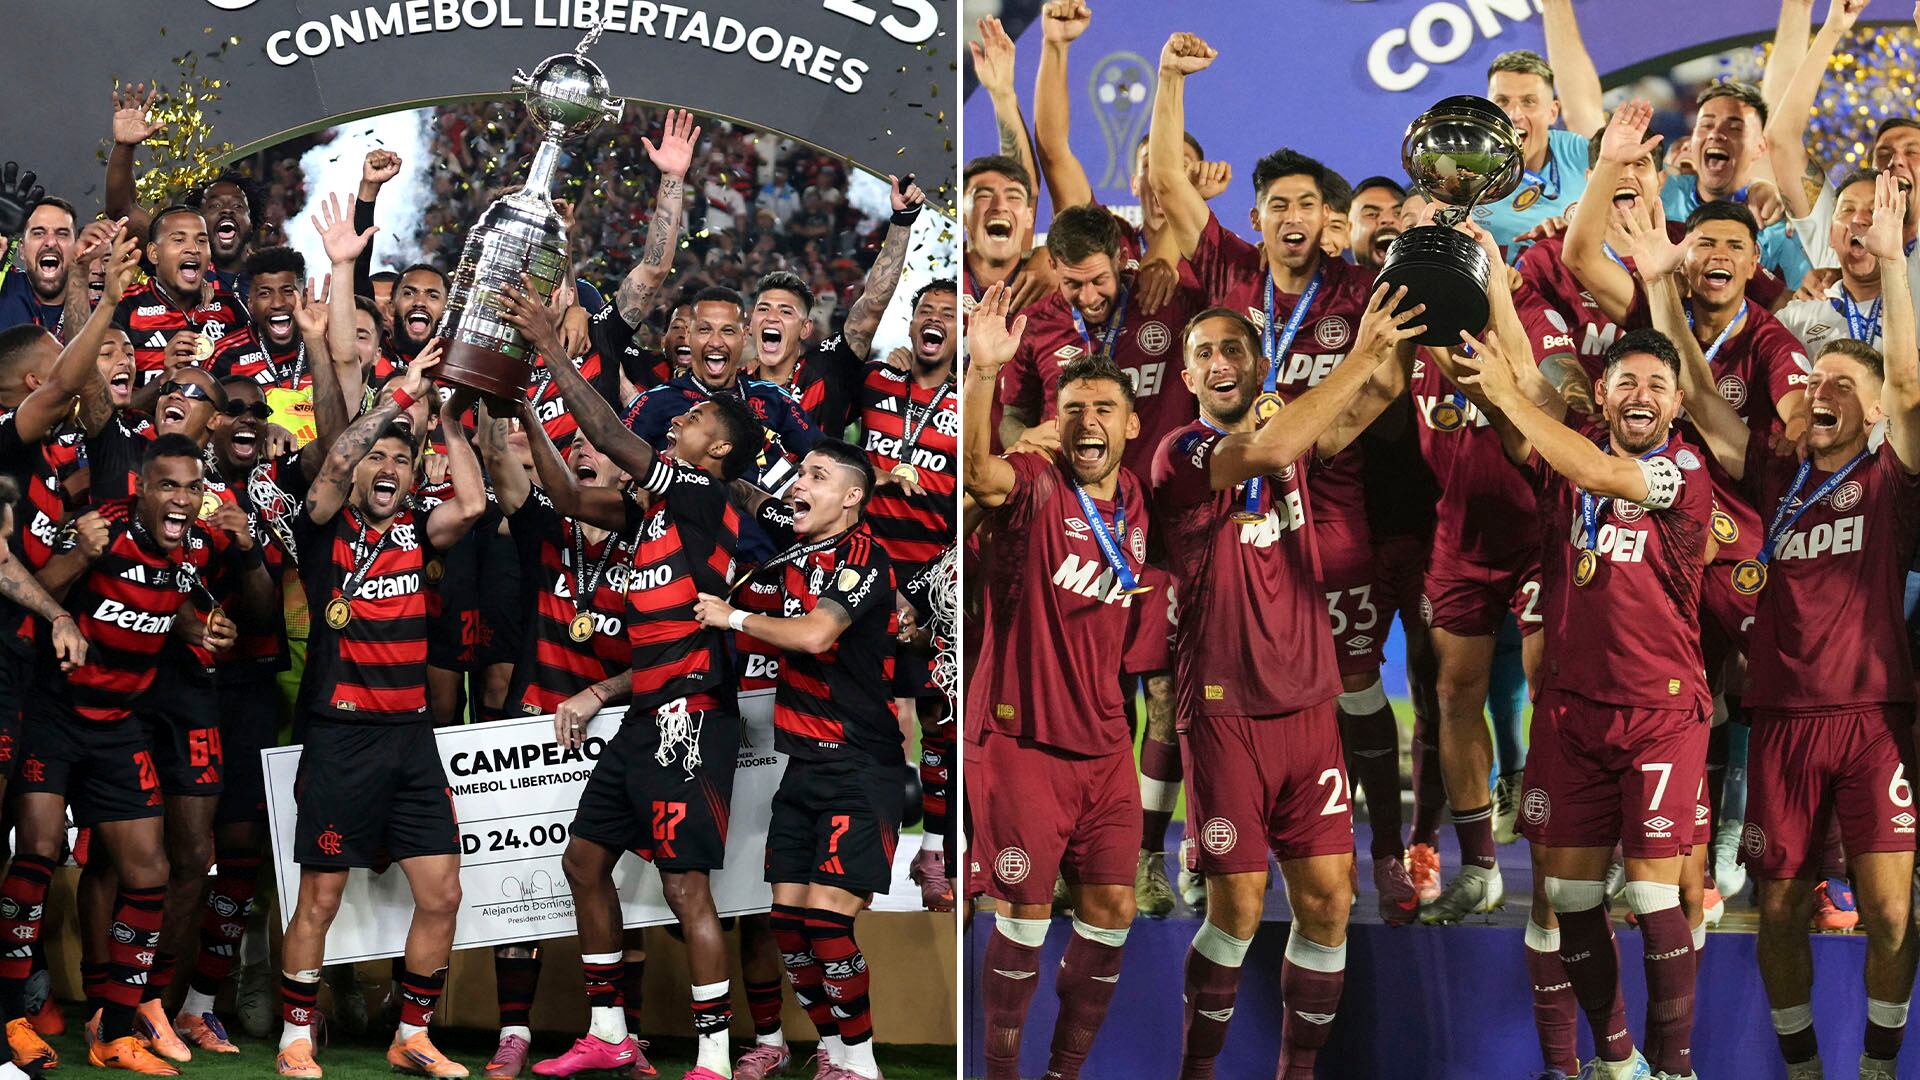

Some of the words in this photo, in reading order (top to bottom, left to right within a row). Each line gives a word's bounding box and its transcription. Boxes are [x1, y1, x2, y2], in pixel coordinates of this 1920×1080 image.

[266, 0, 524, 65] CONMEBOL
[535, 0, 870, 94] LIBERTADORES
[1367, 0, 1544, 91] CON
[1065, 530, 1089, 541] umbro
[1091, 516, 1124, 570] SUDAMERICANA
[847, 567, 879, 608] Shopee
[1325, 584, 1378, 636] 33
[1349, 647, 1373, 656] umbro
[1317, 767, 1351, 816] 2
[1641, 763, 1673, 811] 7
[1888, 762, 1913, 808] 6
[652, 800, 688, 841] 27
[828, 815, 850, 853] 7
[482, 904, 530, 917] Alejandro
[507, 914, 546, 925] Presidente
[824, 961, 852, 975] Zé
